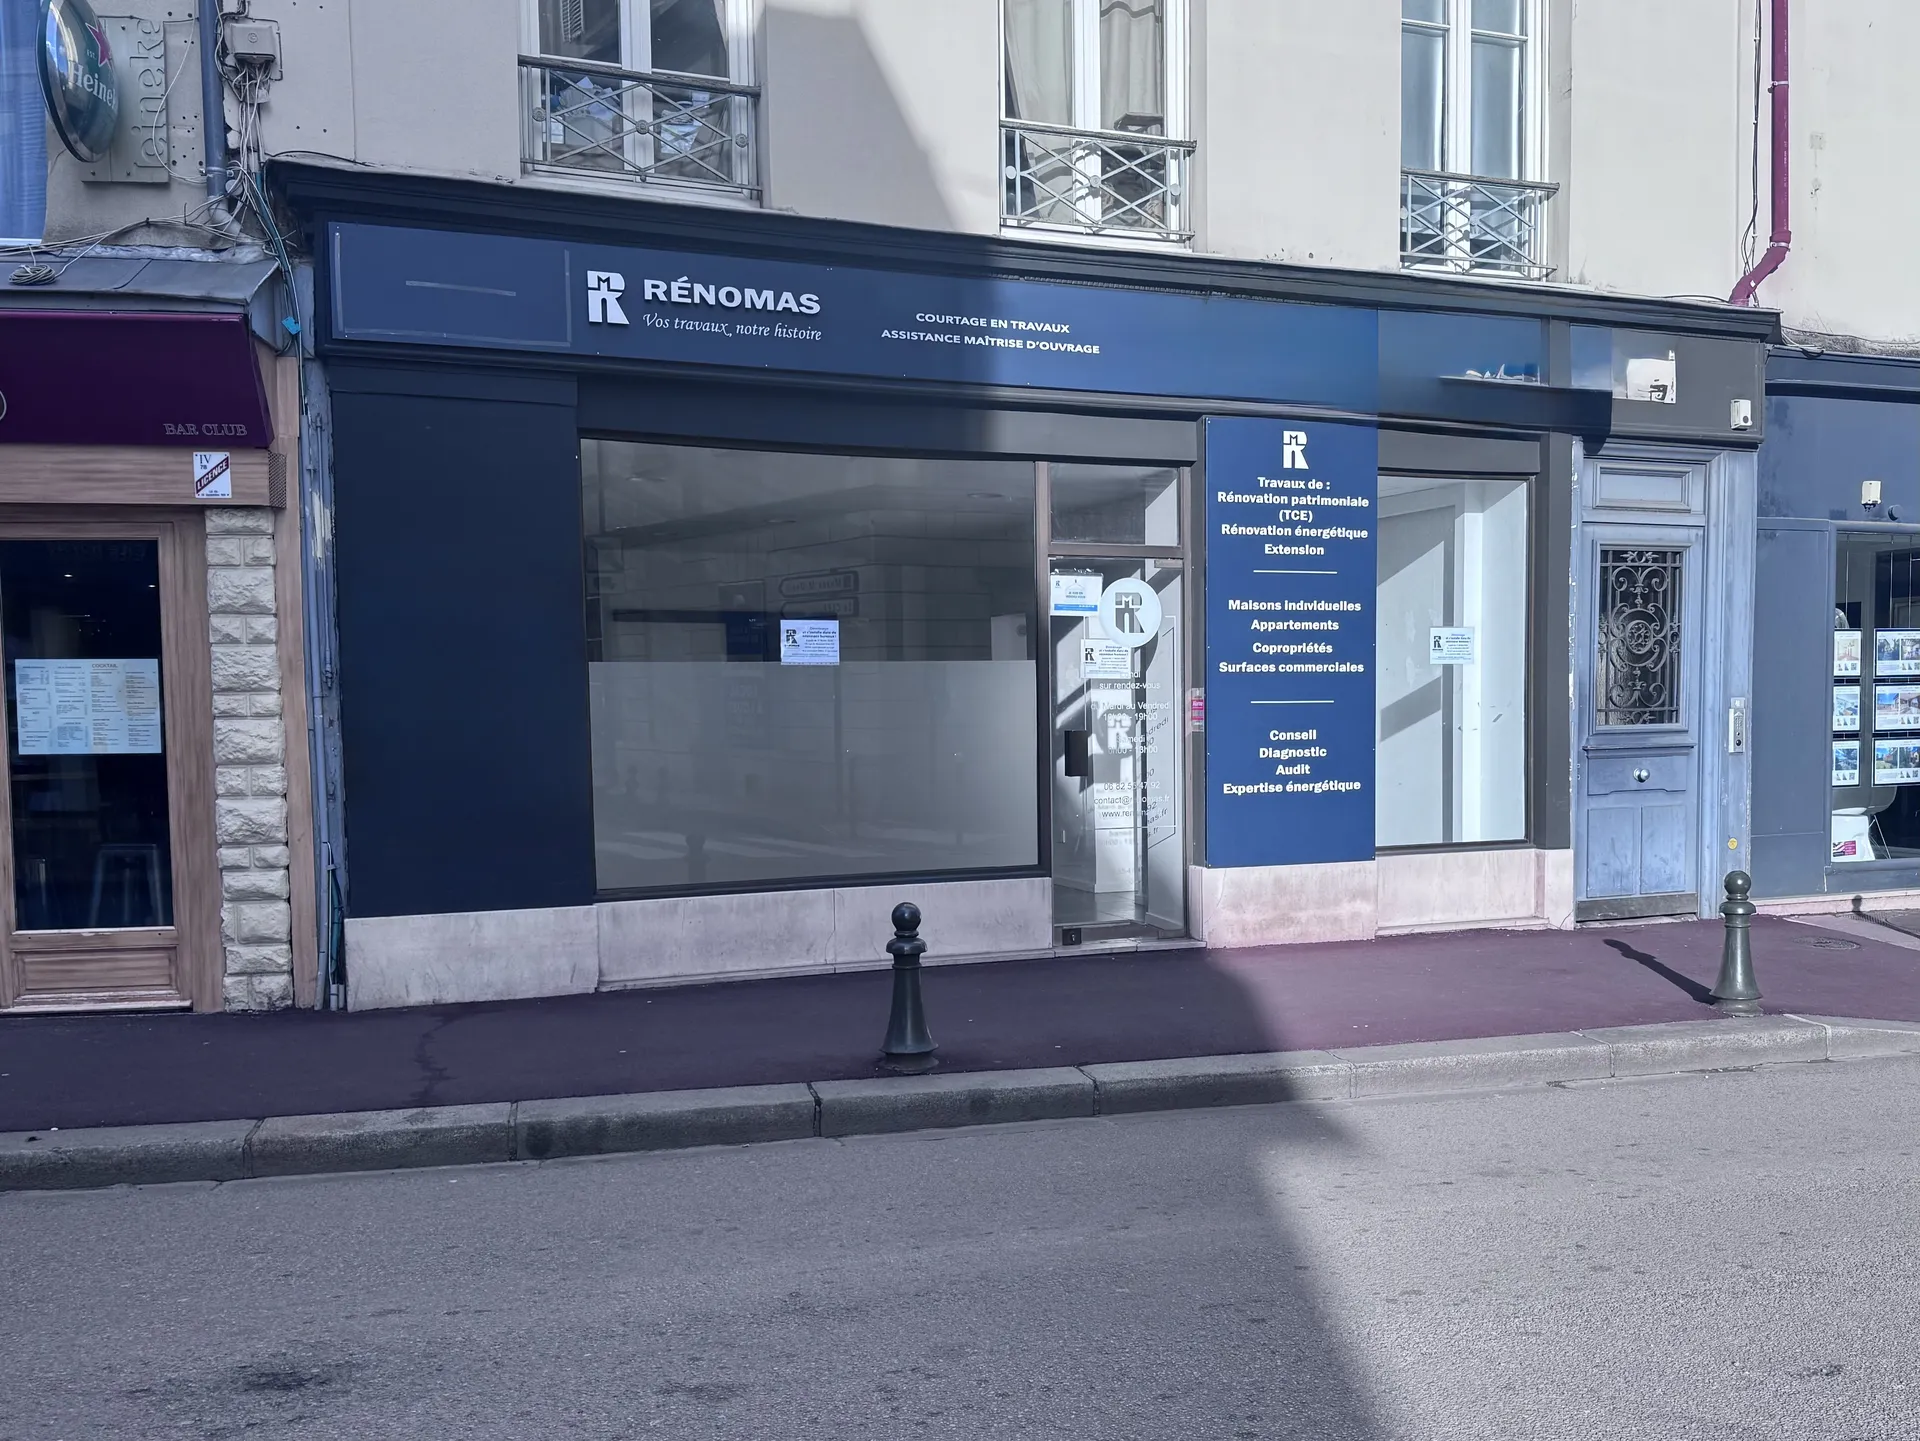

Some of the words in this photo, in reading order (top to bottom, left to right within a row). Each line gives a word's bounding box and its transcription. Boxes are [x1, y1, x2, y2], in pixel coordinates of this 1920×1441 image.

[643, 275, 821, 315] RÉNOMAS
[642, 312, 670, 329] Vos
[674, 317, 733, 337] travaux,
[735, 324, 770, 338] notre
[774, 322, 822, 341] histoire
[915, 312, 987, 328] COURTAGE
[990, 319, 1008, 329] EN
[1010, 320, 1070, 334] TRAVAUX
[881, 329, 961, 344] ASSISTANCE
[964, 334, 1024, 349] MAÎTRISE
[163, 423, 198, 435] BAR
[202, 423, 248, 436] CLUB
[199, 454, 211, 464] IV
[197, 459, 228, 491] LICENCE
[1257, 476, 1306, 490] Travaux
[1307, 478, 1324, 490] de
[1217, 491, 1289, 505] Rénovation
[1291, 493, 1370, 507] patrimoniale
[1278, 509, 1314, 524] (TCE)
[1221, 524, 1292, 537] Rénovation
[1294, 525, 1369, 541] énergétique
[1264, 543, 1325, 556] Extension
[1228, 599, 1282, 611] Maisons
[1284, 599, 1362, 612] individuelles
[1250, 619, 1340, 632] Appartements
[1252, 641, 1333, 655] Copropriétés
[1219, 661, 1276, 673] Surfaces
[1278, 661, 1365, 673] commerciales
[1113, 681, 1161, 690] rendez-vous
[1269, 729, 1317, 741] Conseil
[1259, 747, 1328, 760] Diagnostic
[1275, 763, 1311, 776] Audit
[1223, 782, 1283, 796] Expertise
[1285, 780, 1362, 794] énergétique
